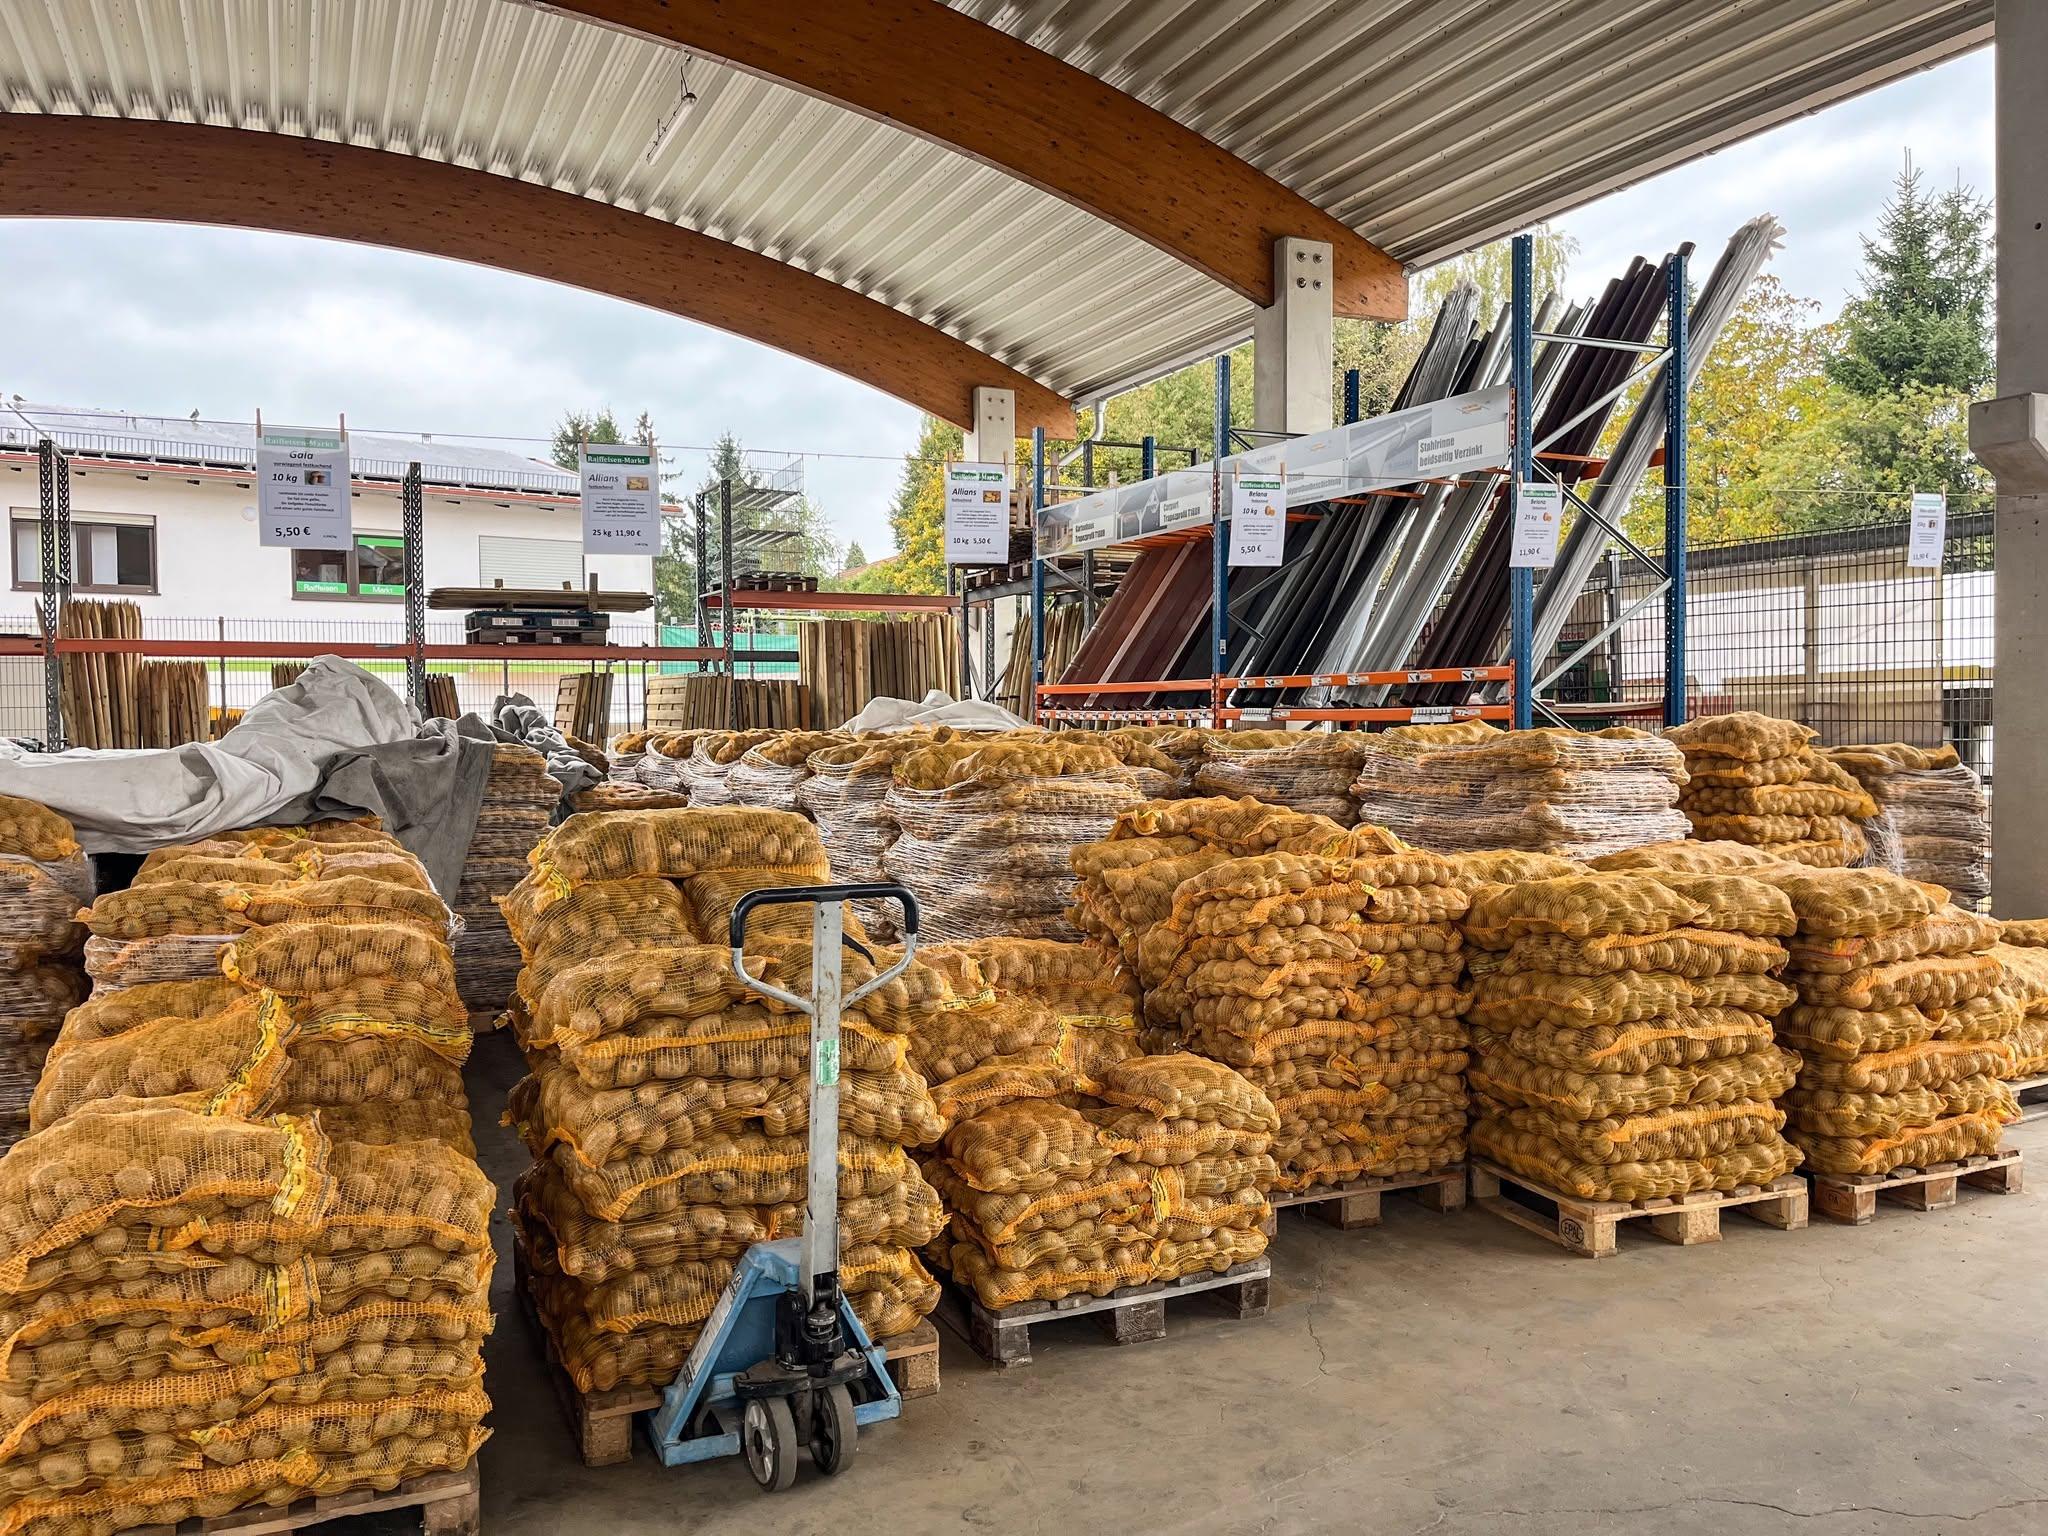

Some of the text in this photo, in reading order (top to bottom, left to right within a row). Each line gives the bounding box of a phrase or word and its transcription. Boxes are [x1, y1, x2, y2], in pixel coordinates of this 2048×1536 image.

[1420, 437, 1455, 453] Stahlrinne
[289, 450, 314, 460] Gala
[587, 455, 645, 464] Raiffeisen-Markt
[1419, 444, 1483, 466] beidseitig Verzinkt
[272, 473, 298, 483] 10 kg
[588, 473, 619, 482] Allians
[951, 488, 977, 496] Allians
[1250, 507, 1258, 515] kg
[275, 526, 311, 538] 5,50 €
[592, 528, 602, 536] 25
[603, 528, 612, 537] kg
[615, 529, 636, 537] 11,90
[961, 537, 969, 545] kg
[973, 537, 987, 545] 5,50
[1240, 544, 1262, 555] 5,50 €
[1519, 548, 1536, 556] 11,90
[303, 583, 339, 592] Raiffeisen
